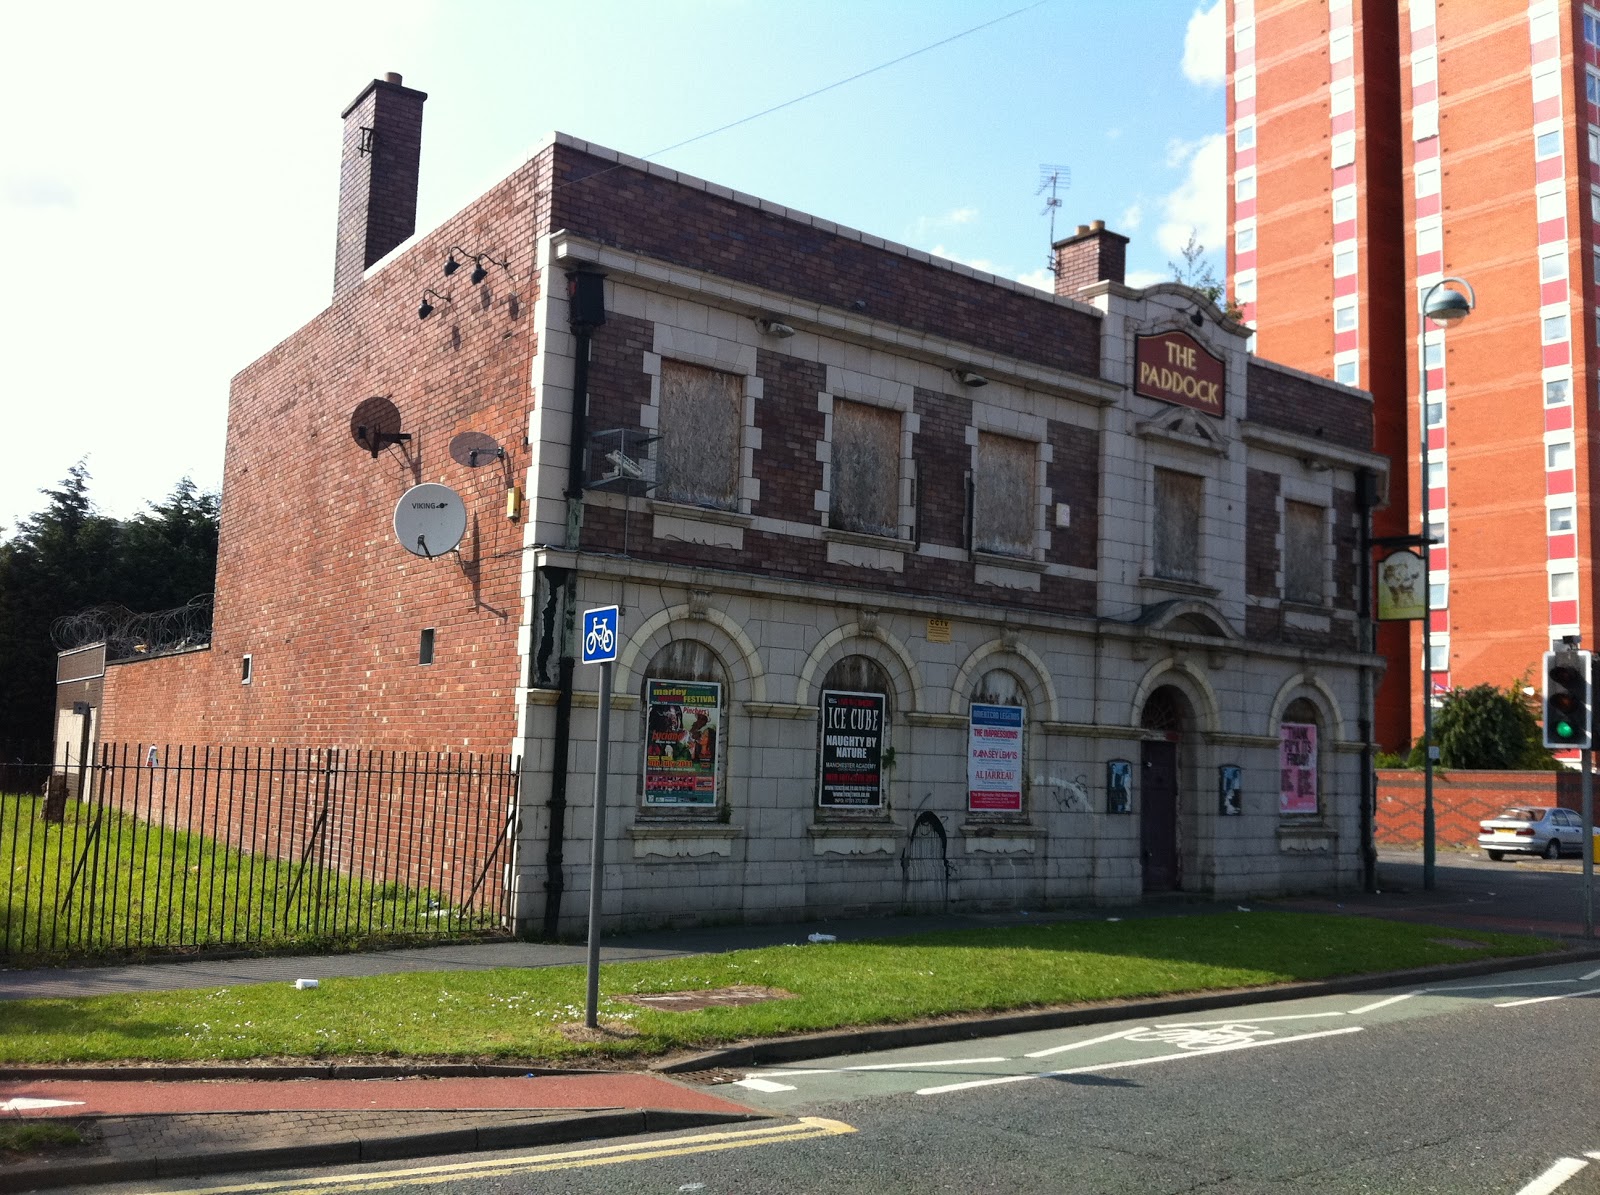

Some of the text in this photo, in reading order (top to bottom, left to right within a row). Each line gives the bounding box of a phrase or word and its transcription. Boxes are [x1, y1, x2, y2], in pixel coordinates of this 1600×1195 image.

[1165, 340, 1197, 371] THE
[1140, 361, 1219, 405] PADDOCK
[653, 688, 687, 697] marley
[683, 695, 716, 703] FESTIVAL
[827, 706, 879, 731] ICE CUBE
[973, 728, 1018, 739] THE IMPRESSIONS
[826, 734, 877, 748] NAUGHTY BY
[836, 746, 867, 759] NATURE
[973, 749, 1018, 759] RAMSEY LEWIS
[975, 770, 984, 779] AL
[984, 771, 1014, 780] JARREAU
